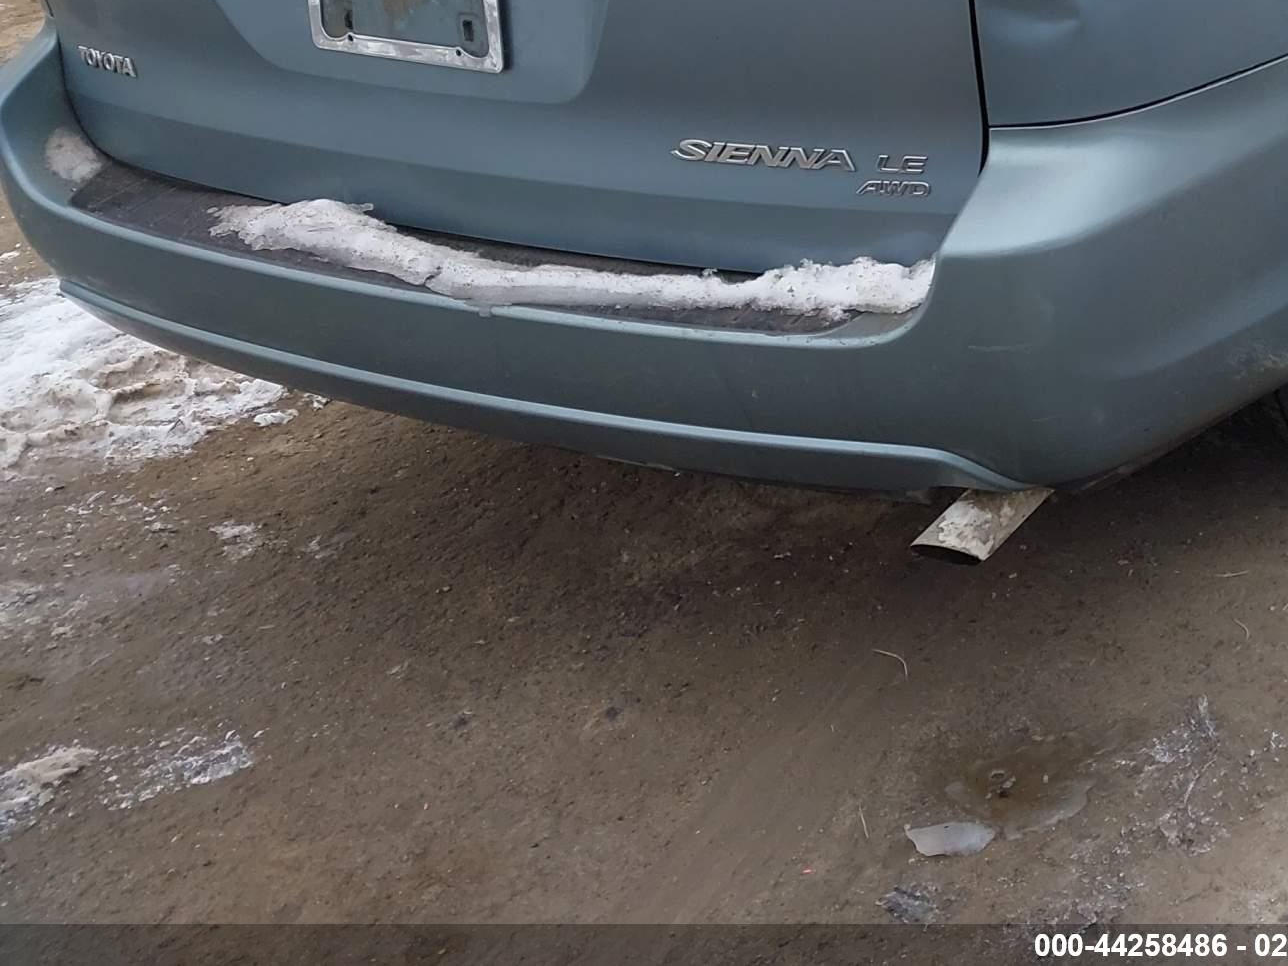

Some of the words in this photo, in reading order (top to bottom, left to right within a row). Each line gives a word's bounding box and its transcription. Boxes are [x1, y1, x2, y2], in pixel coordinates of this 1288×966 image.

[77, 44, 137, 78] TOYOTA
[670, 138, 856, 172] SIENNA
[876, 154, 928, 174] LE
[855, 180, 931, 197] AWD
